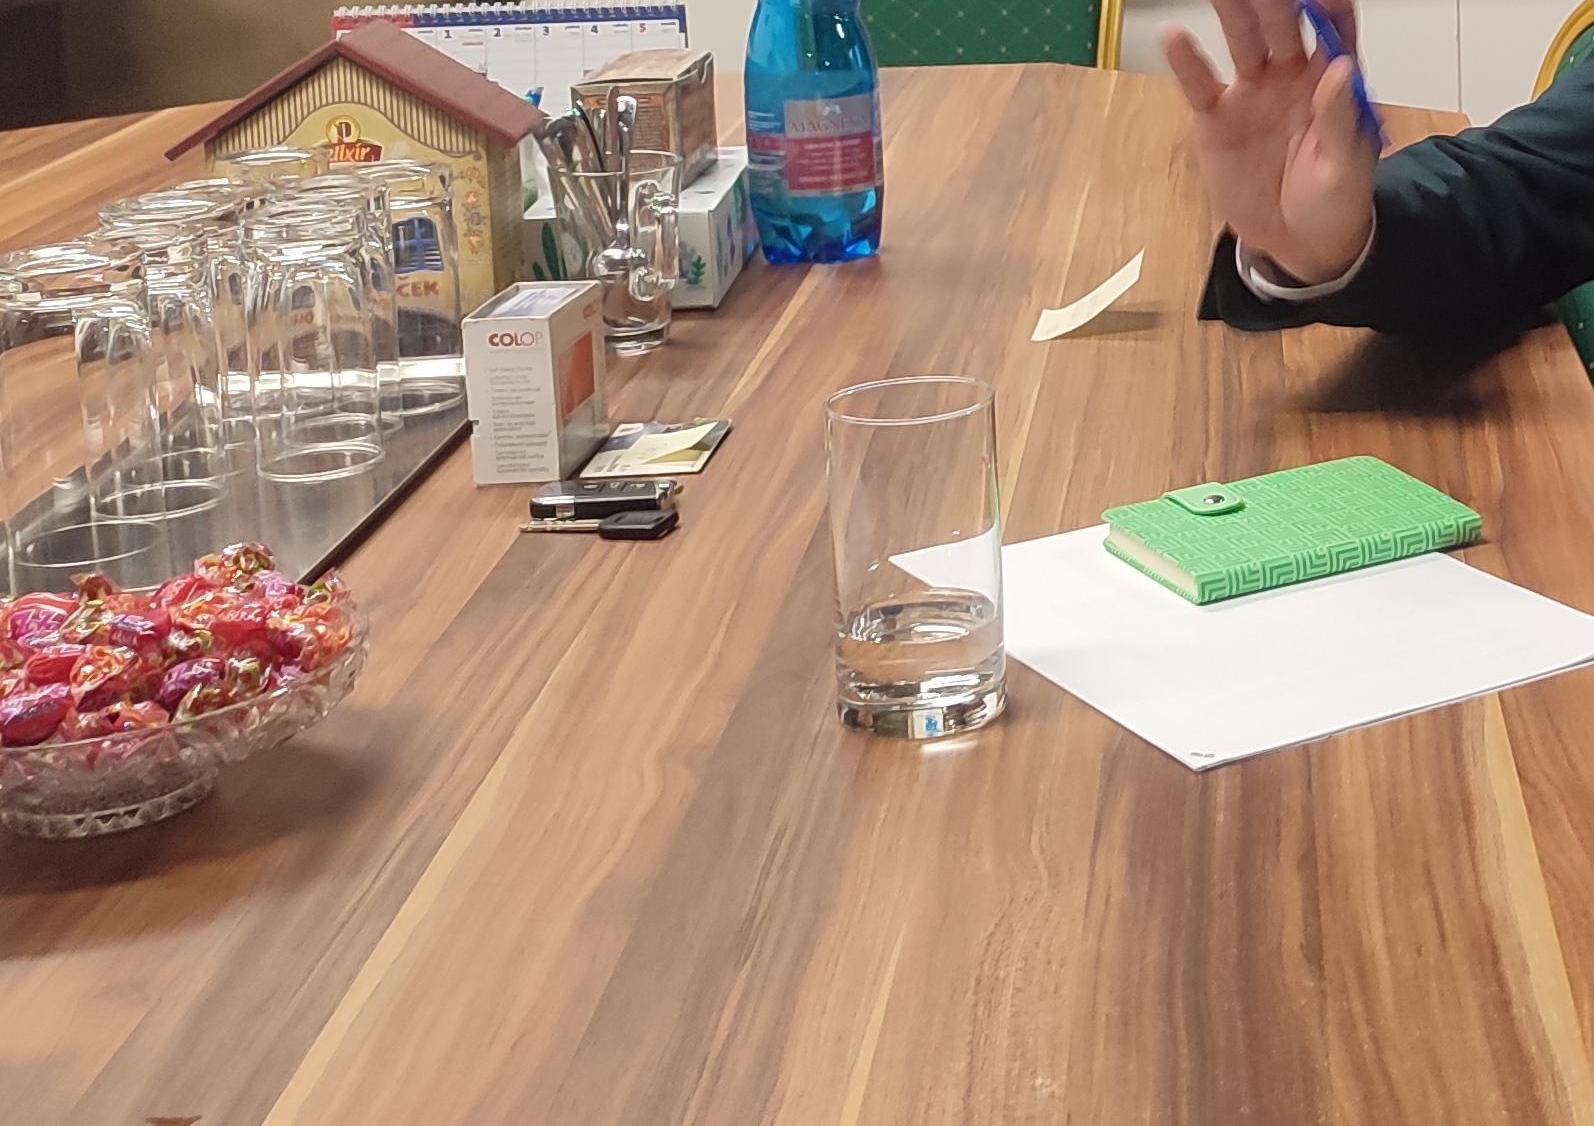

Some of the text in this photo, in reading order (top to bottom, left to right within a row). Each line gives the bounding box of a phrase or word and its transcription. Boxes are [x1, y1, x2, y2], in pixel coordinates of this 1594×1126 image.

[444, 30, 453, 39] 1
[493, 28, 502, 38] 2
[543, 25, 551, 37] 3
[590, 24, 599, 34] 4
[639, 22, 648, 33] 5
[488, 331, 543, 347] COLOP
